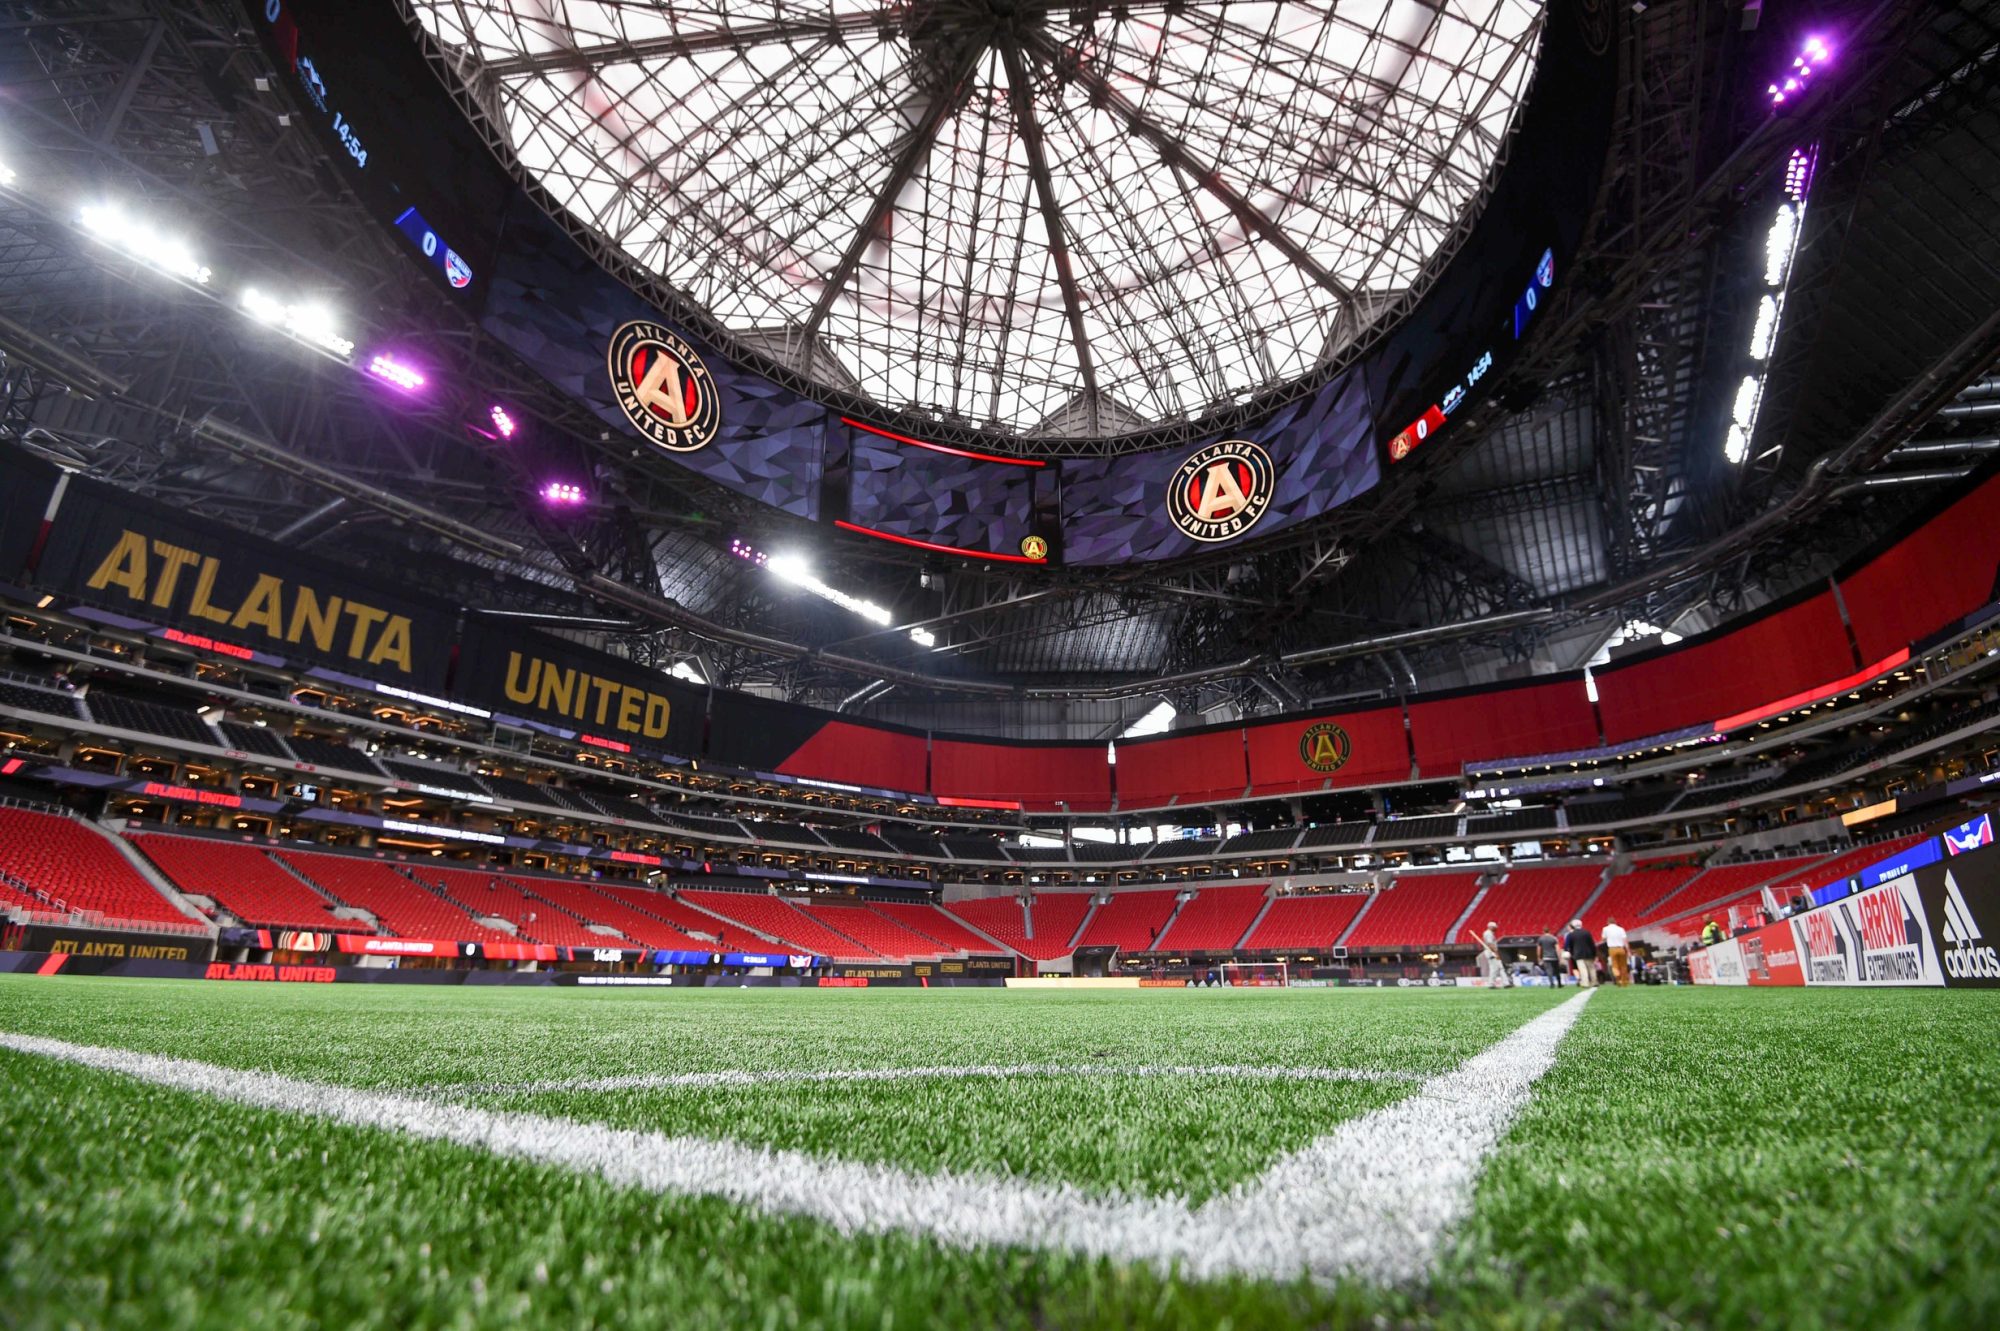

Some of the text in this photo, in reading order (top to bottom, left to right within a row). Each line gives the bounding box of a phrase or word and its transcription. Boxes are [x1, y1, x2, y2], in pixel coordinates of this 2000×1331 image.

[332, 112, 368, 168] 14:54
[422, 231, 437, 257] 0
[1526, 287, 1536, 310] 0
[634, 325, 705, 378] ATLANTA
[1467, 351, 1492, 387] 14:54
[617, 381, 705, 445] UNITED FC
[1416, 419, 1428, 440] 0
[1183, 443, 1252, 475] ATLANTA
[1180, 495, 1265, 537] UNITED FC
[86, 529, 413, 673] ATLANTA
[504, 651, 671, 739] UNITED
[144, 781, 242, 808] ATLANTA UNITED
[1804, 908, 1838, 958] ARROW
[1857, 885, 1908, 950] ARROW
[50, 939, 188, 961] ATLANTA UNITED
[365, 940, 403, 951] ATLANTA
[1944, 939, 2000, 978] adidas
[205, 963, 336, 983] ATLANTA UNITED
[844, 969, 902, 978] ATLANTA UNITED
[1867, 950, 1919, 982] EXTERMINATORS
